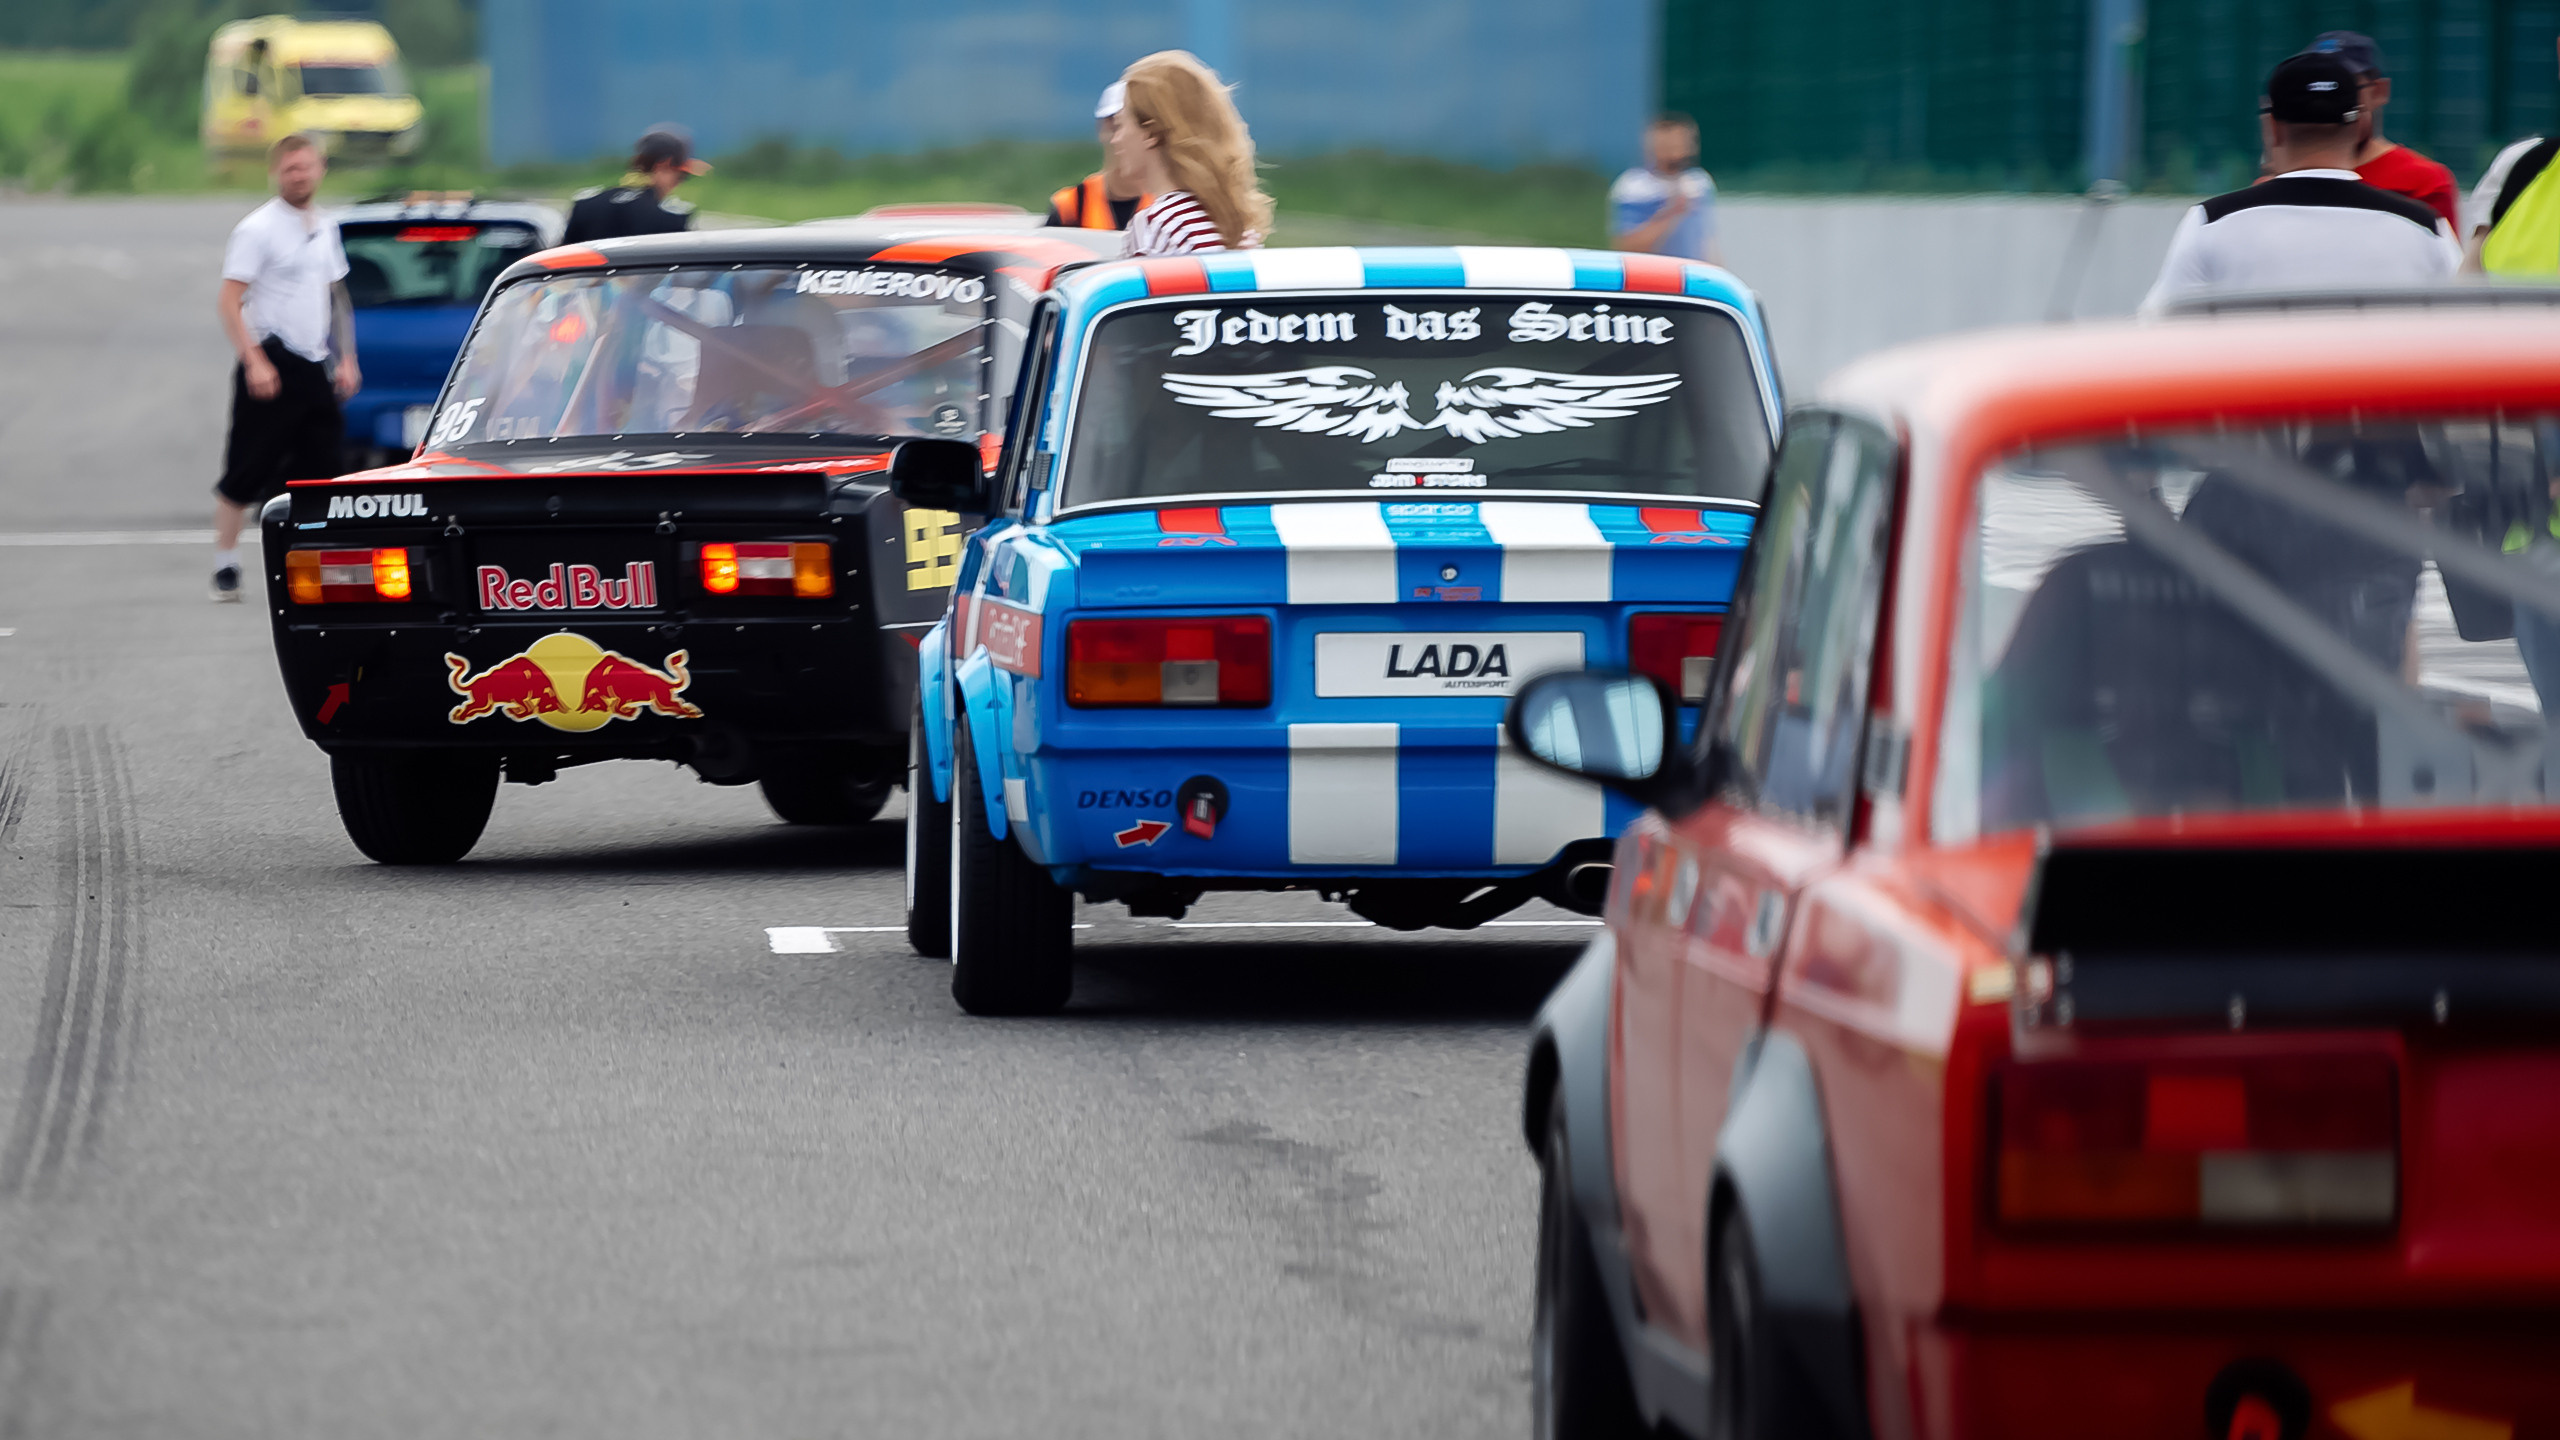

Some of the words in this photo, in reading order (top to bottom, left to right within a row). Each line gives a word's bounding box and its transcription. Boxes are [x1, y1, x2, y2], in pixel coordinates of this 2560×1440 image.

[796, 269, 985, 304] KEMEROVO
[1171, 307, 1358, 358] Jedem
[1384, 303, 1482, 341] das
[1508, 301, 1675, 346] Seine
[428, 397, 487, 447] 95
[326, 493, 429, 519] MOTUL
[476, 562, 567, 611] Red
[568, 561, 658, 610] Bull
[1384, 642, 1511, 678] LADA
[1077, 788, 1174, 809] DENSO
